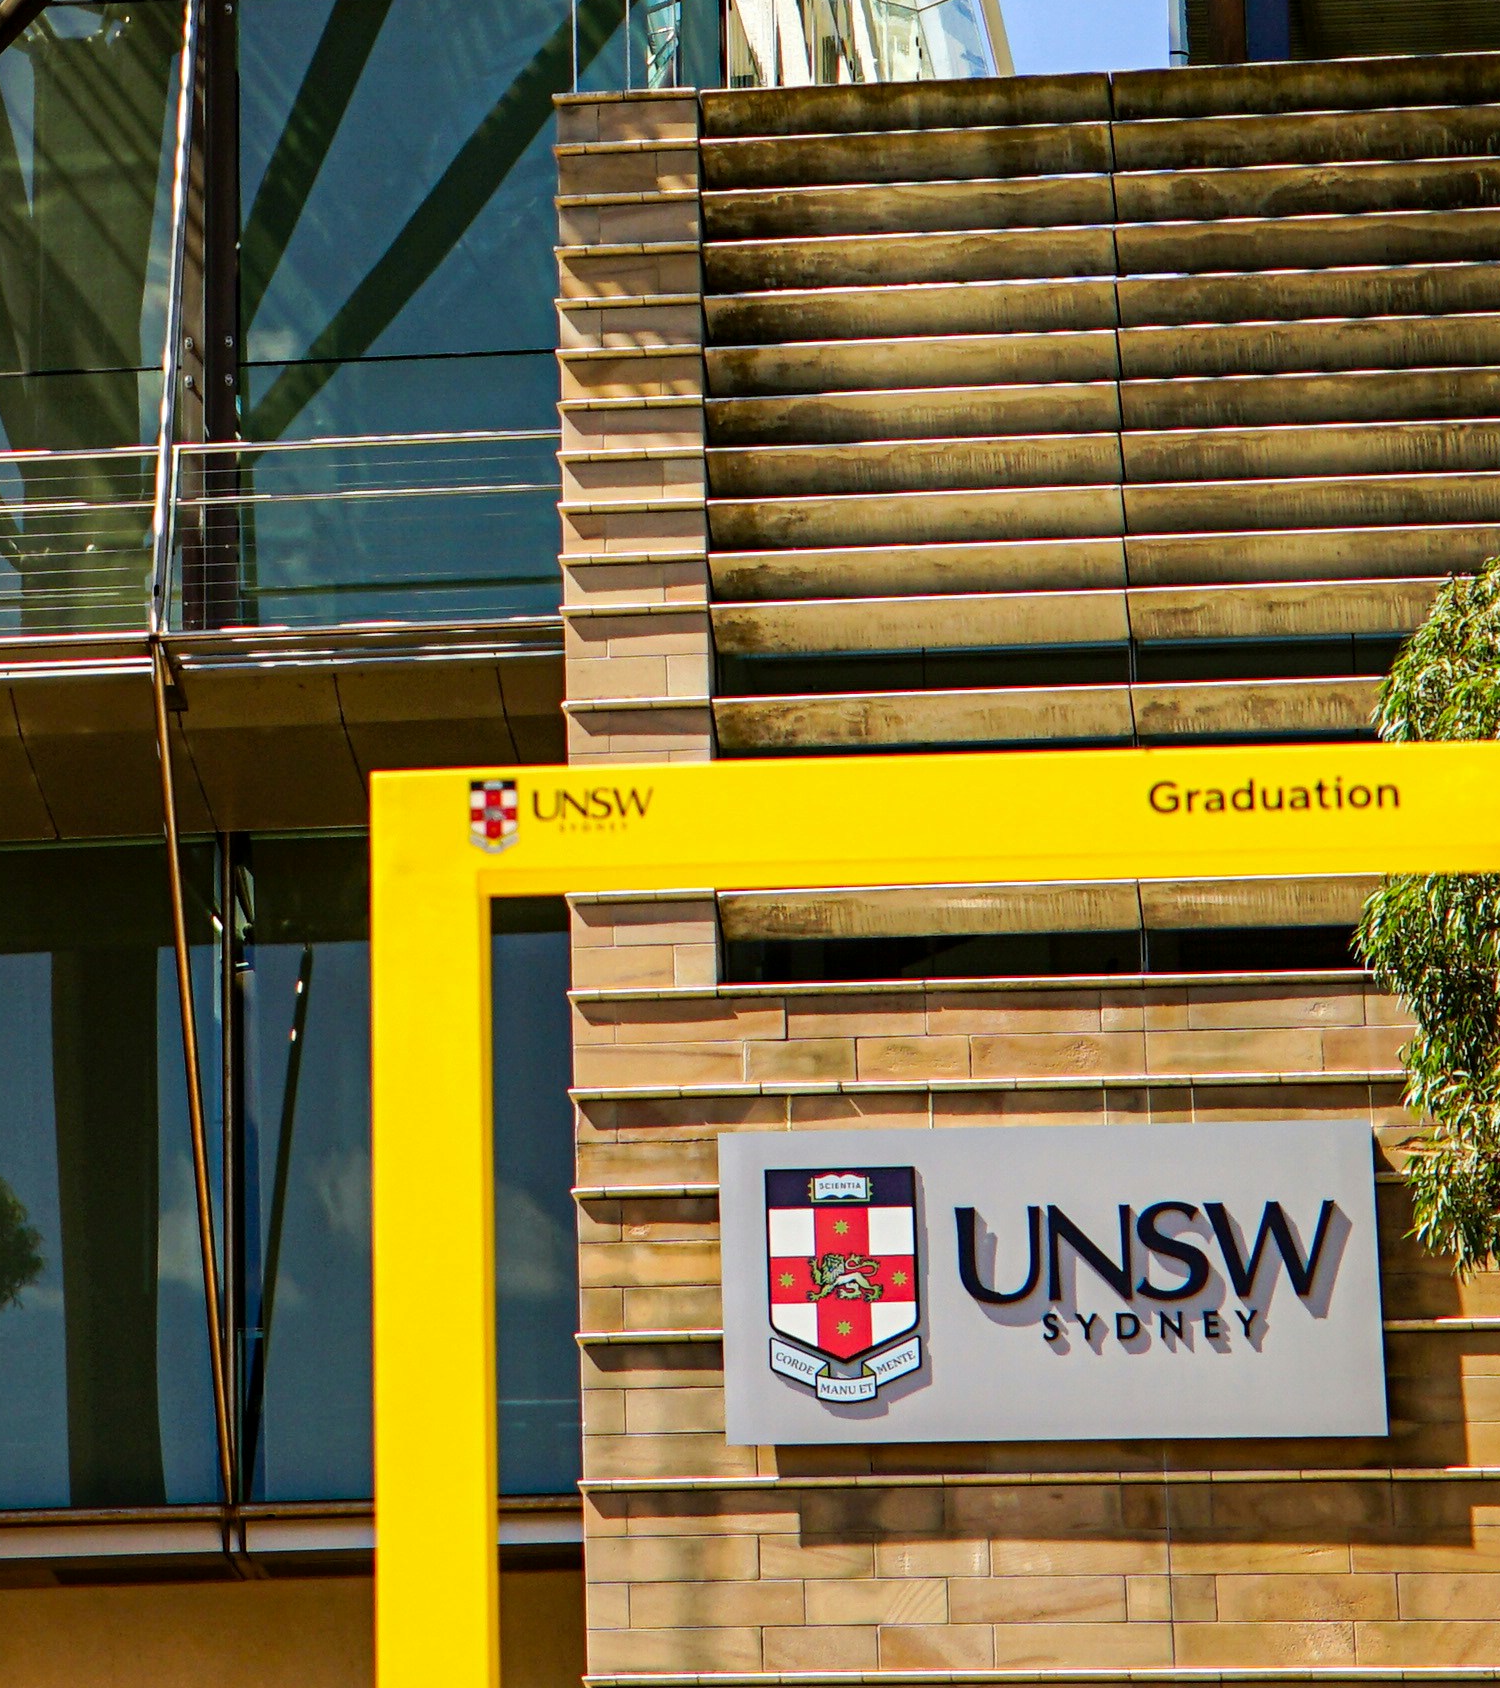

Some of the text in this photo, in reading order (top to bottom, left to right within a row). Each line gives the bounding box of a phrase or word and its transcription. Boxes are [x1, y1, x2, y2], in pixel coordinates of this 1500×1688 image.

[532, 786, 655, 822] UNSW
[1148, 775, 1400, 814] Graduation
[818, 1181, 863, 1191] SCIENTIA
[953, 1198, 1336, 1306] UNSW
[1042, 1309, 1259, 1343] SYDNEY
[774, 1349, 917, 1396] CORDE MANU ET MENTE
